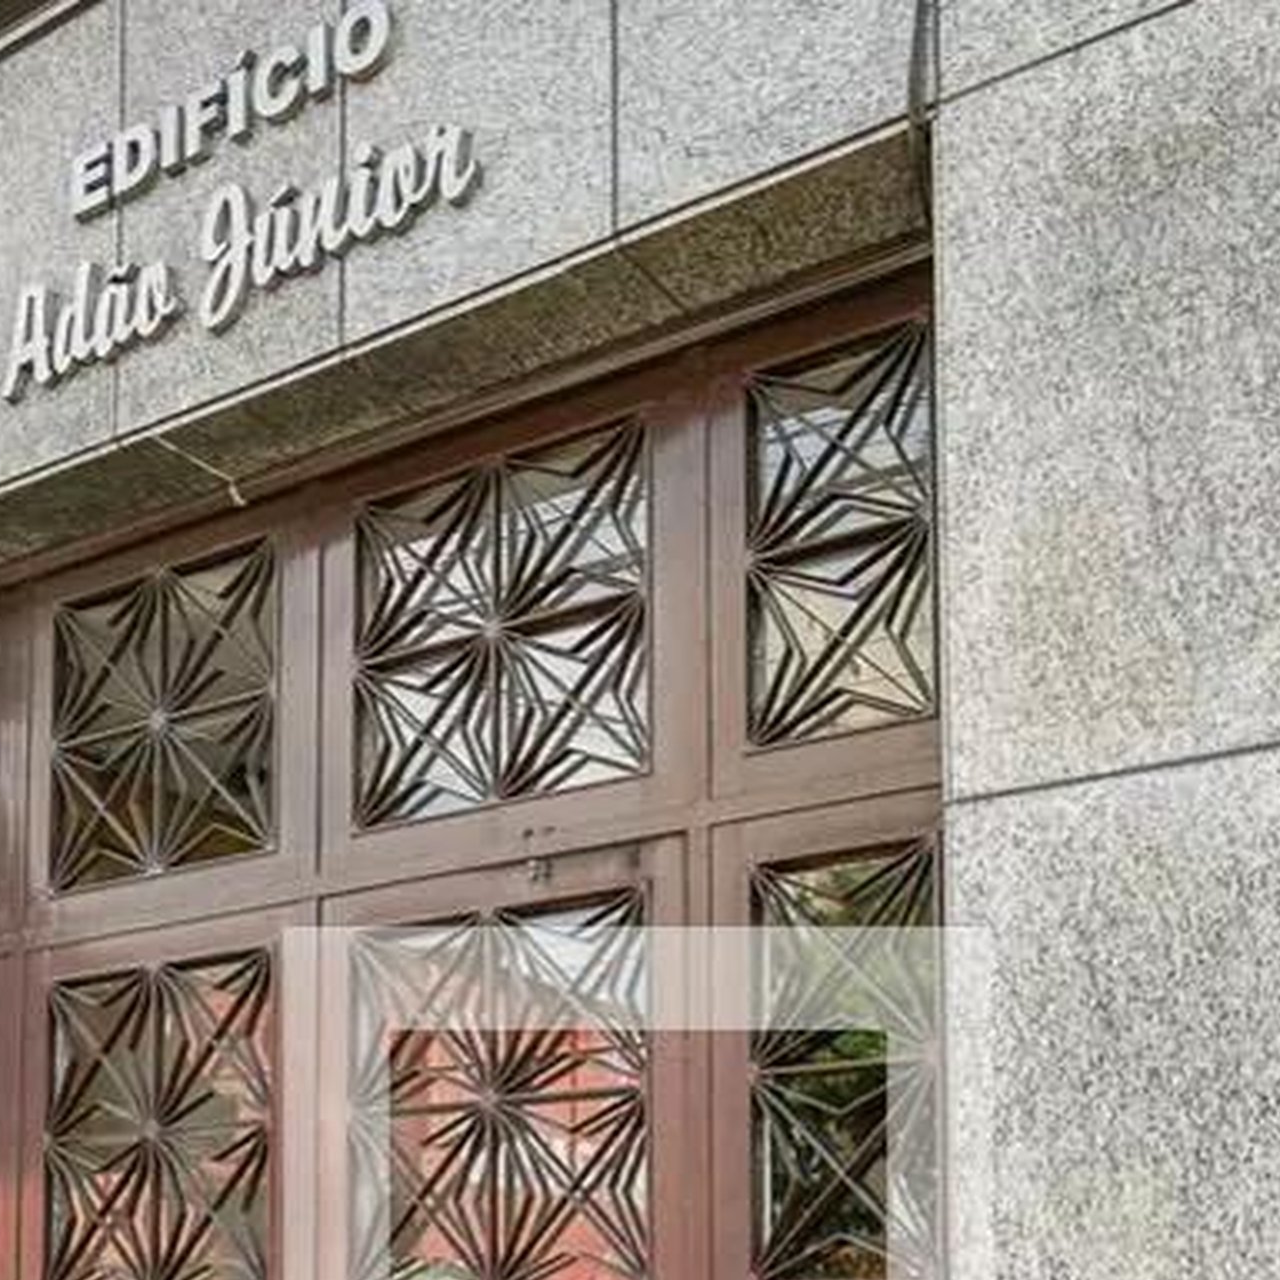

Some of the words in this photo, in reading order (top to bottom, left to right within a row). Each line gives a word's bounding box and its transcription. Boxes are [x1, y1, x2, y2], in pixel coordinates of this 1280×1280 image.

[72, 0, 391, 216] EDIFÍCIO
[1, 260, 177, 400] Adão
[199, 122, 480, 330] Júnior
